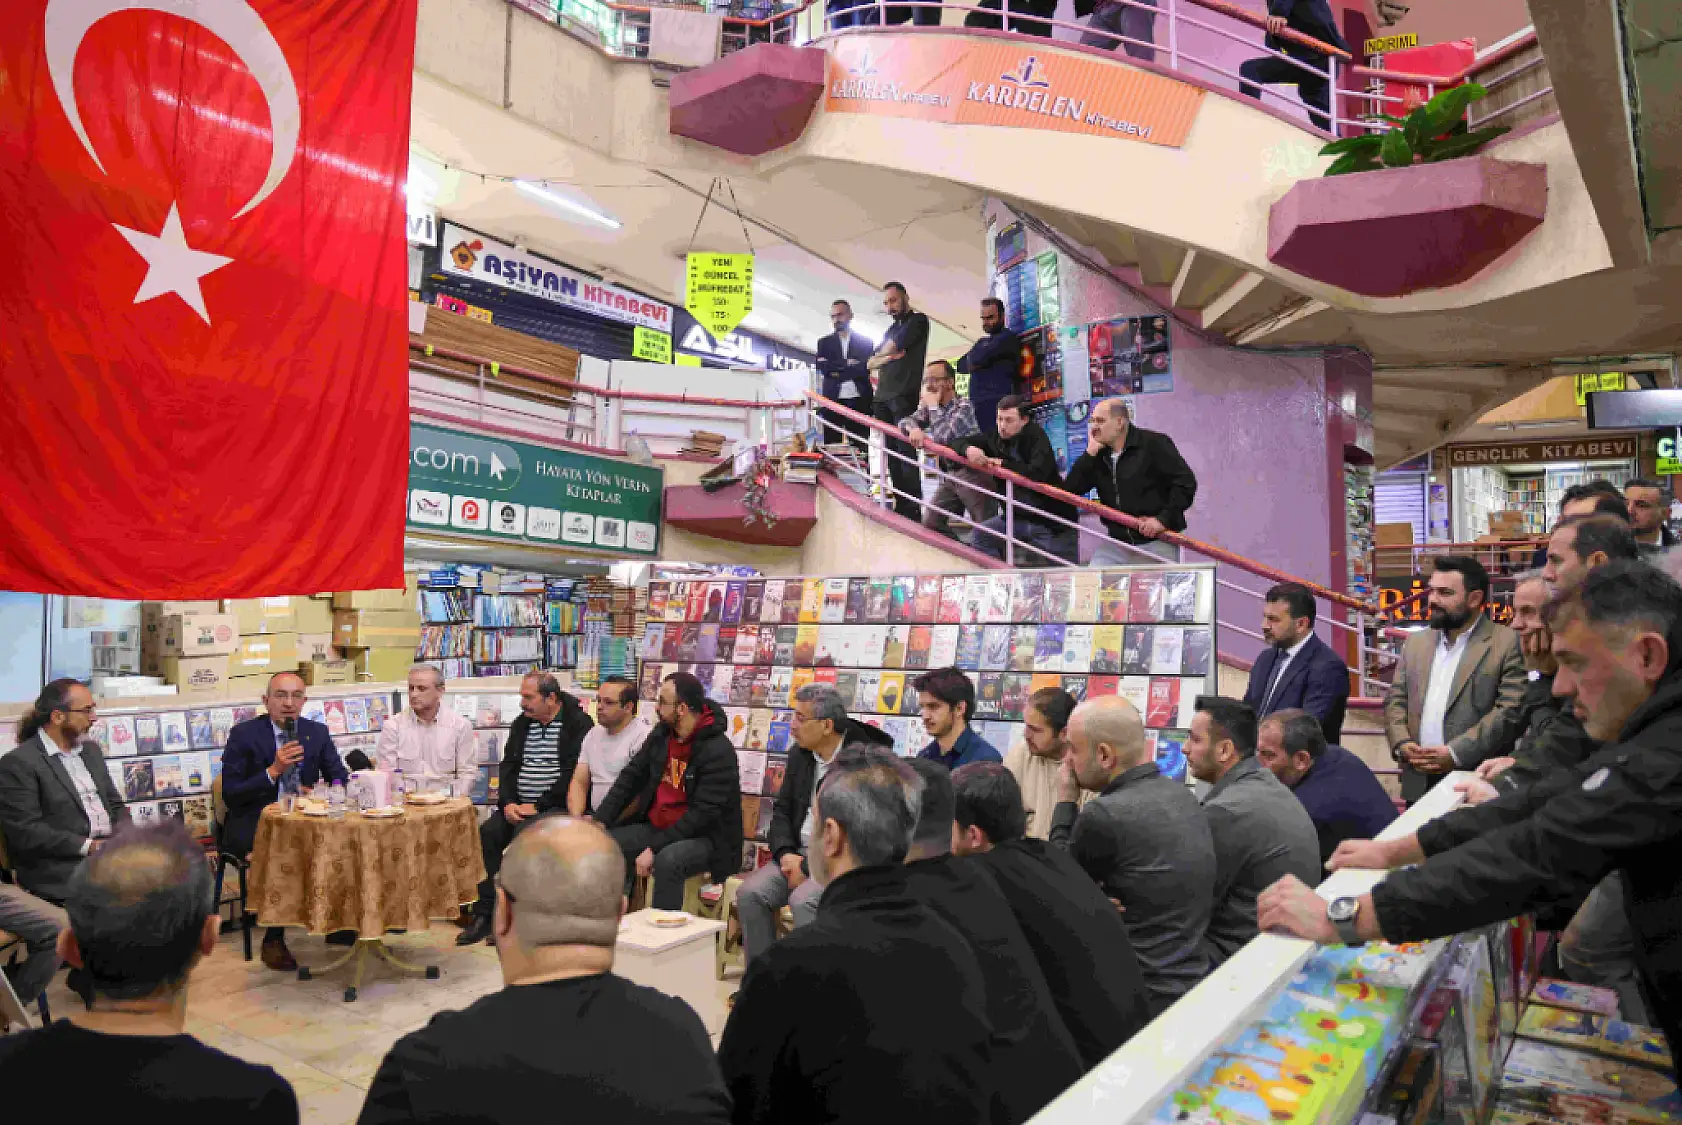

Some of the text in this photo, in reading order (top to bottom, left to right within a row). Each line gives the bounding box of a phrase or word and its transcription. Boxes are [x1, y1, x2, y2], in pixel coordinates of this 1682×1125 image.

[966, 80, 1085, 121] KARDELEN
[1453, 441, 1632, 463] GENÇLİK KİTABEVİ
